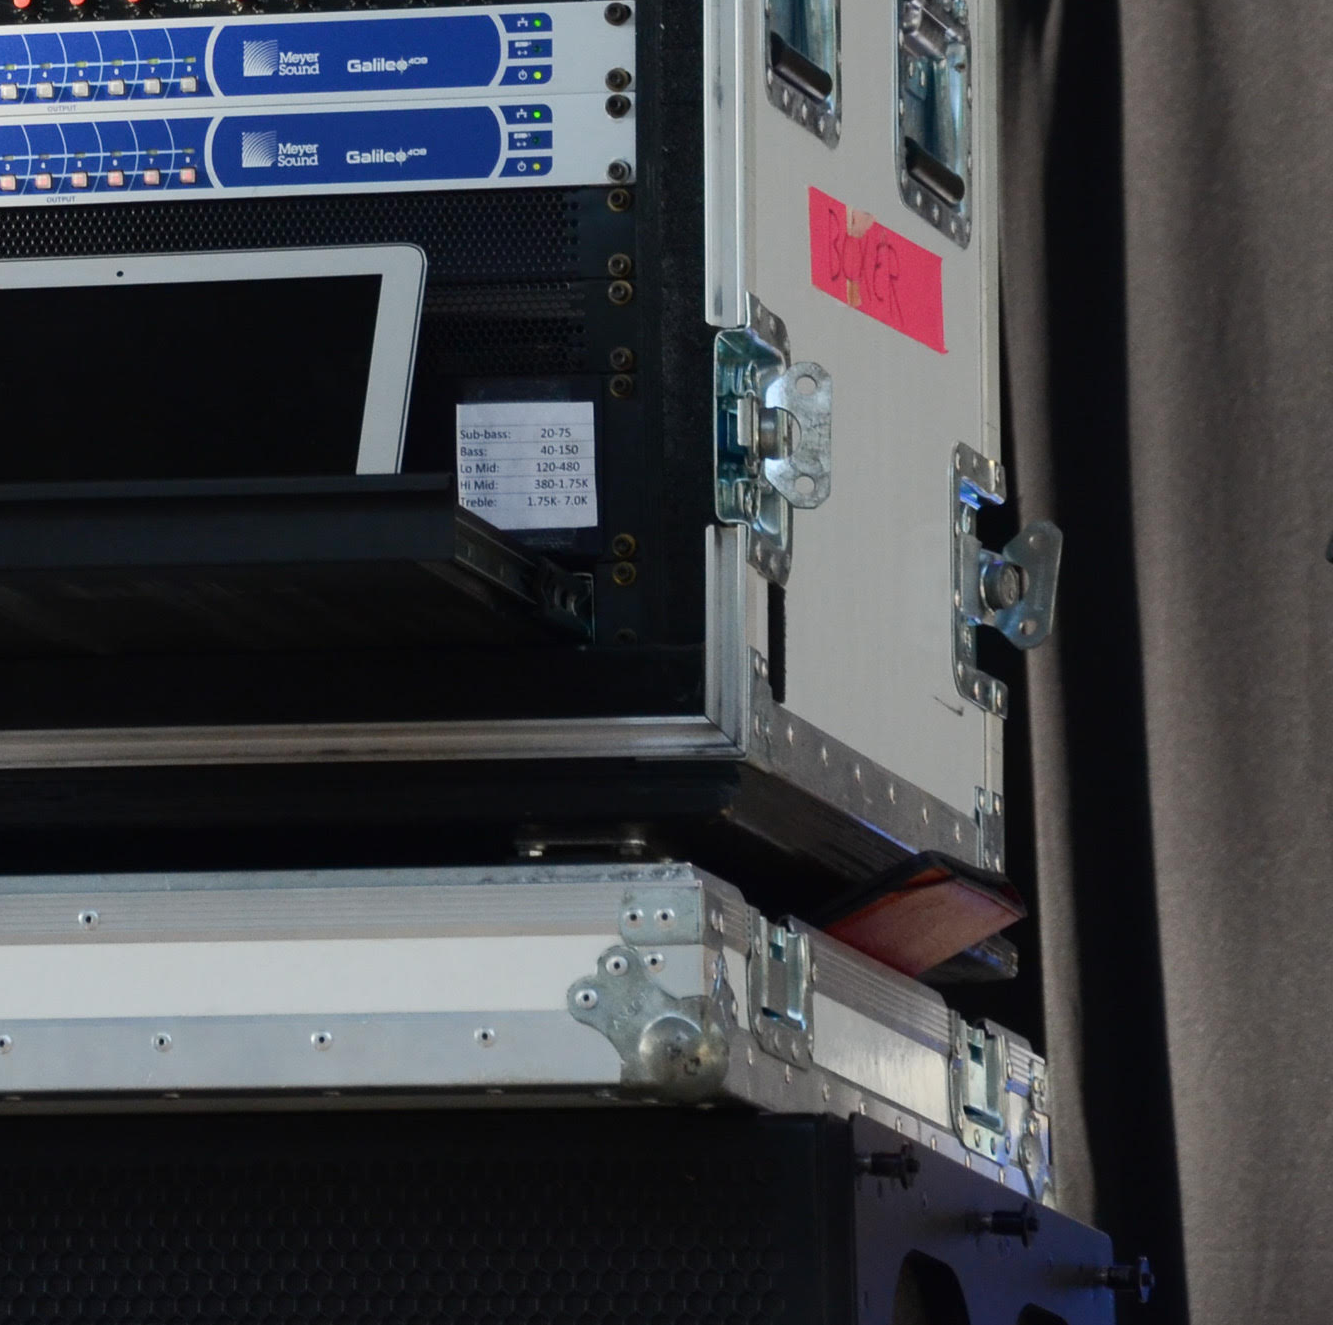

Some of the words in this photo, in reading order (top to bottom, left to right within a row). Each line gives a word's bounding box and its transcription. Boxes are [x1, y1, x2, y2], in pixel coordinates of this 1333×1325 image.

[279, 51, 320, 64] Meyer
[278, 64, 320, 76] Sound
[47, 104, 77, 112] OUTPUT
[278, 143, 319, 155] Meyer
[278, 154, 319, 167] Sound
[46, 195, 76, 203] OUTPUT
[460, 429, 512, 440] Sub-bass:
[540, 428, 572, 438] 20-75
[460, 446, 488, 457] Bass:
[540, 445, 579, 455] 40-150
[460, 464, 472, 474] Lo
[475, 463, 500, 473] Mid:
[536, 462, 580, 473] 120-480
[460, 480, 471, 490] Hi
[474, 480, 499, 490] Mid:
[534, 478, 589, 490] 380-1.75K
[461, 497, 498, 508] Treble:
[565, 495, 588, 506] 7.0K
